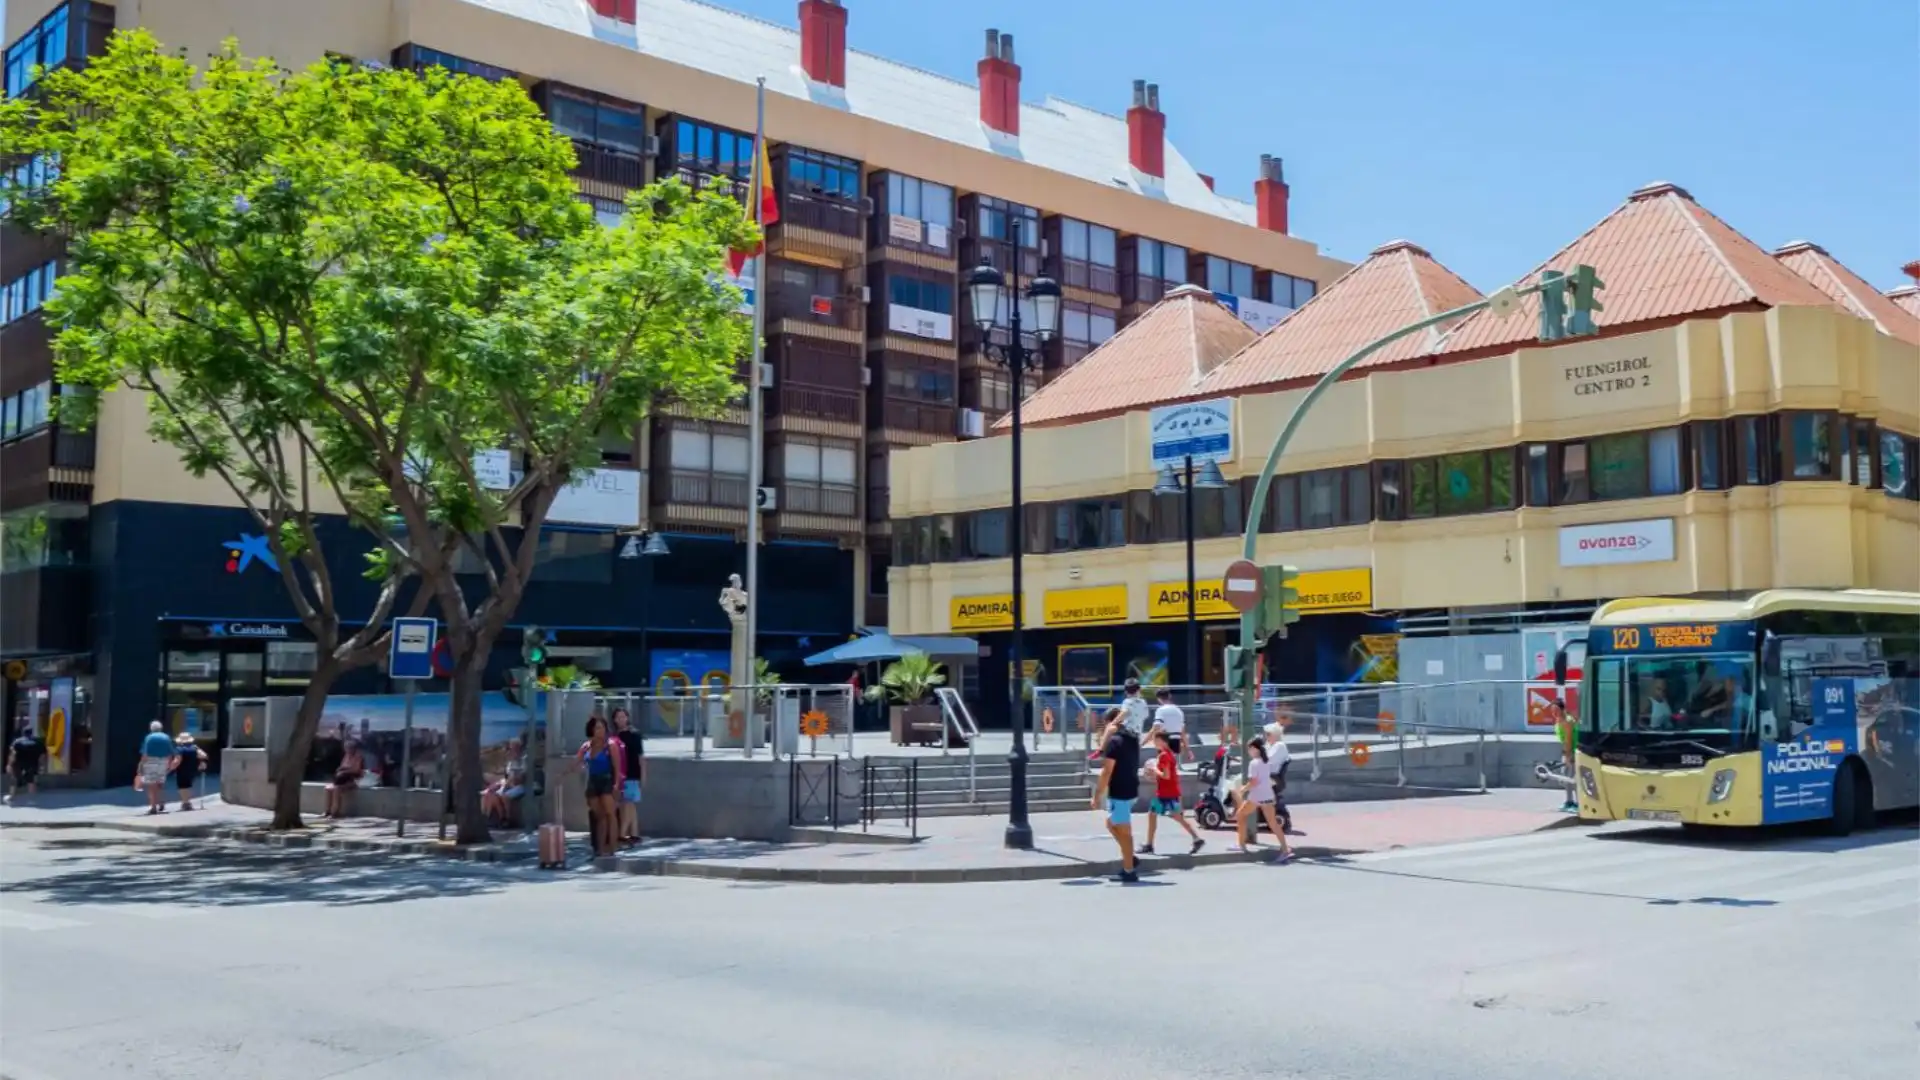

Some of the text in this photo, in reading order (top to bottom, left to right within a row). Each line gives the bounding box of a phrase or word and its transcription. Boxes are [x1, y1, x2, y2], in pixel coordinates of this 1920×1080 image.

[1565, 357, 1651, 380] FUENGIROL
[1574, 375, 1651, 395] CENTRO 2
[1579, 535, 1637, 550] avanza
[1613, 628, 1639, 649] 120
[1824, 687, 1845, 704] 091
[1767, 756, 1837, 774] NACIONAL
